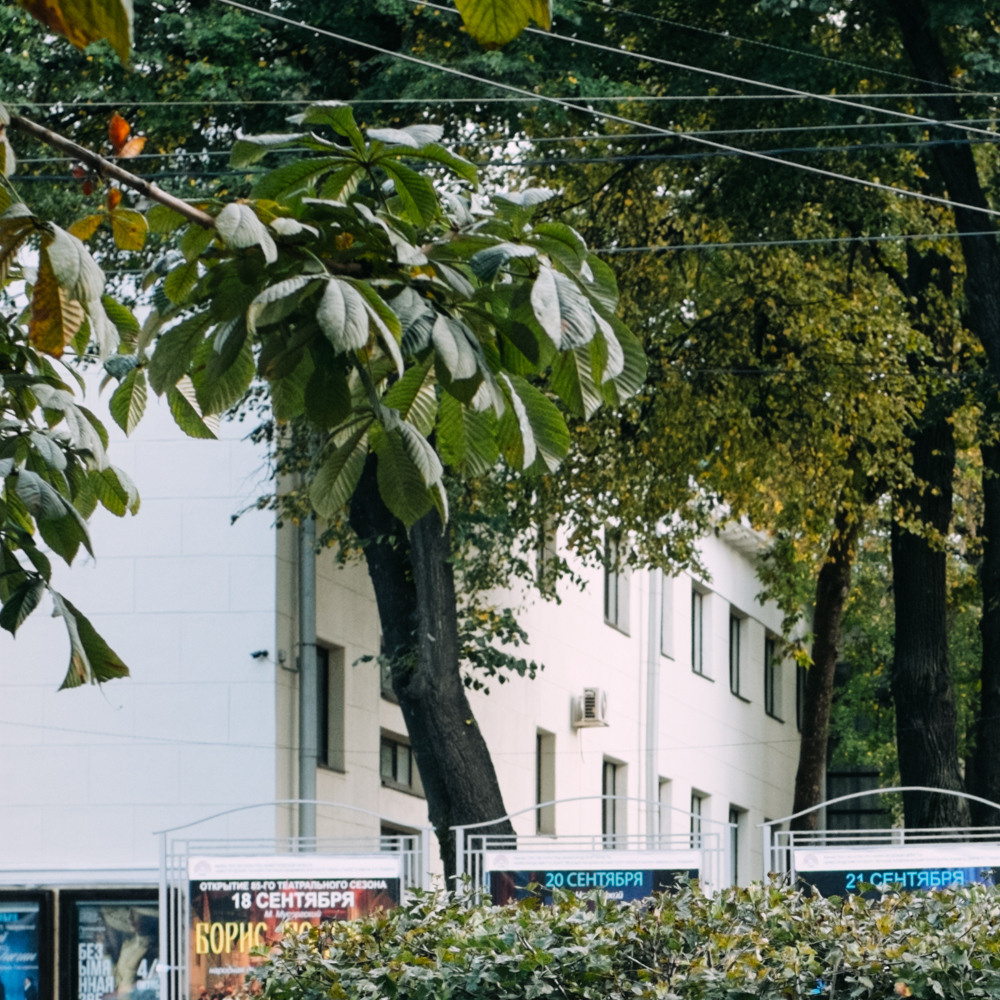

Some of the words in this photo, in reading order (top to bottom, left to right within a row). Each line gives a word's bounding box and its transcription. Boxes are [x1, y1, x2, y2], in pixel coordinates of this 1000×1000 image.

[199, 881, 249, 891] ОТКРЫТИЕ
[278, 880, 348, 890] ТЕАТРАЛЬНОГО
[350, 880, 388, 890] СЕЗОНА
[545, 872, 564, 888] 20
[566, 871, 644, 888] СЕНТЯБРЯ
[845, 872, 863, 889] 21
[869, 870, 965, 888] СЕНТЯБРЯ
[231, 892, 252, 909] 18
[255, 891, 355, 909] СЕНТЯБРЯ
[195, 921, 269, 955] БОРИС
[78, 942, 104, 960] БЕЗ
[78, 959, 112, 976] ЫМЯ
[78, 976, 115, 993] ННАЯ
